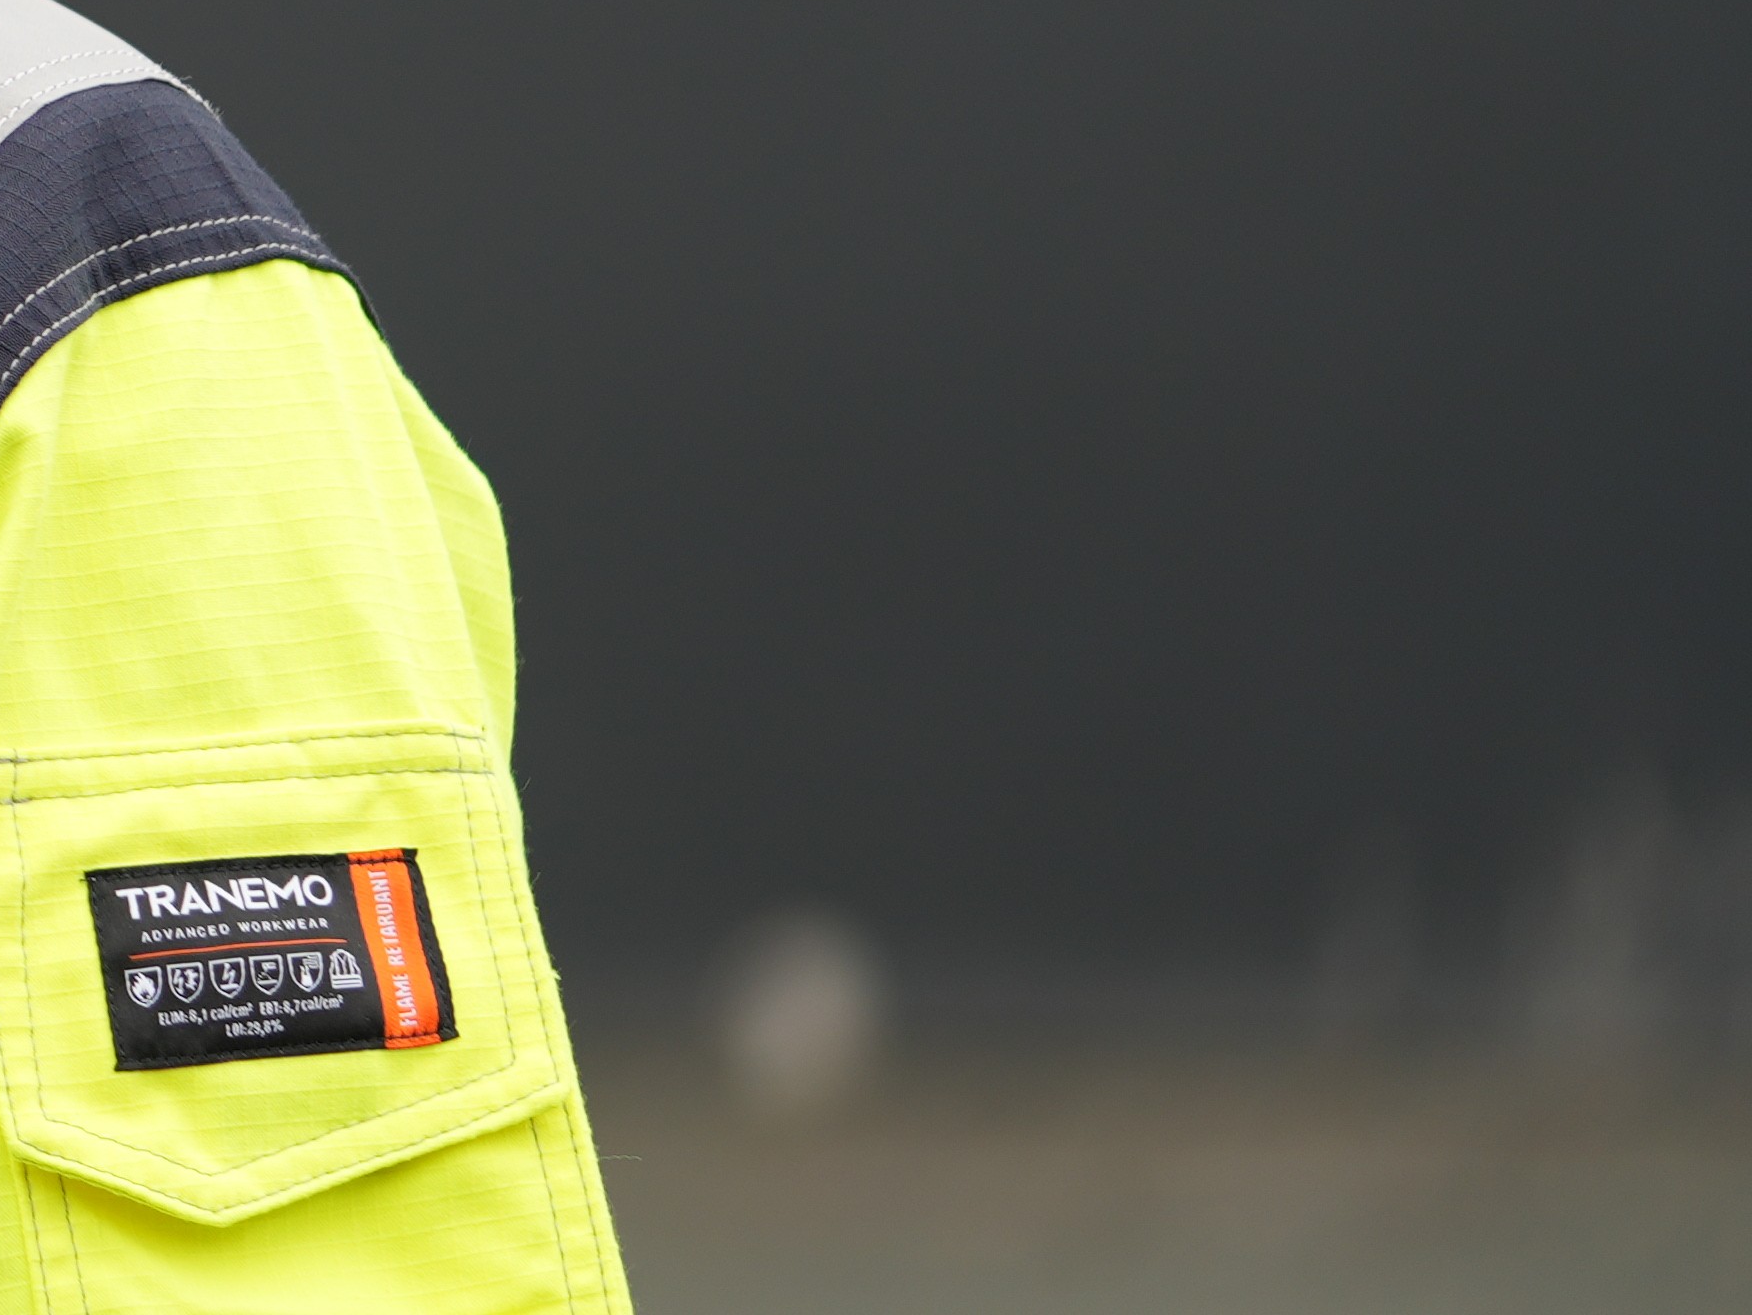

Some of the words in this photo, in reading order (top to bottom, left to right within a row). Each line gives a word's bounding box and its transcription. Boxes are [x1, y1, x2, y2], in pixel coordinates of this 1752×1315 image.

[114, 874, 333, 920] TRANEMO
[368, 870, 407, 966] RETARDANT
[141, 923, 230, 944] ADVANCED
[237, 917, 329, 934] WORKWEAR
[392, 973, 418, 1027] FLAME
